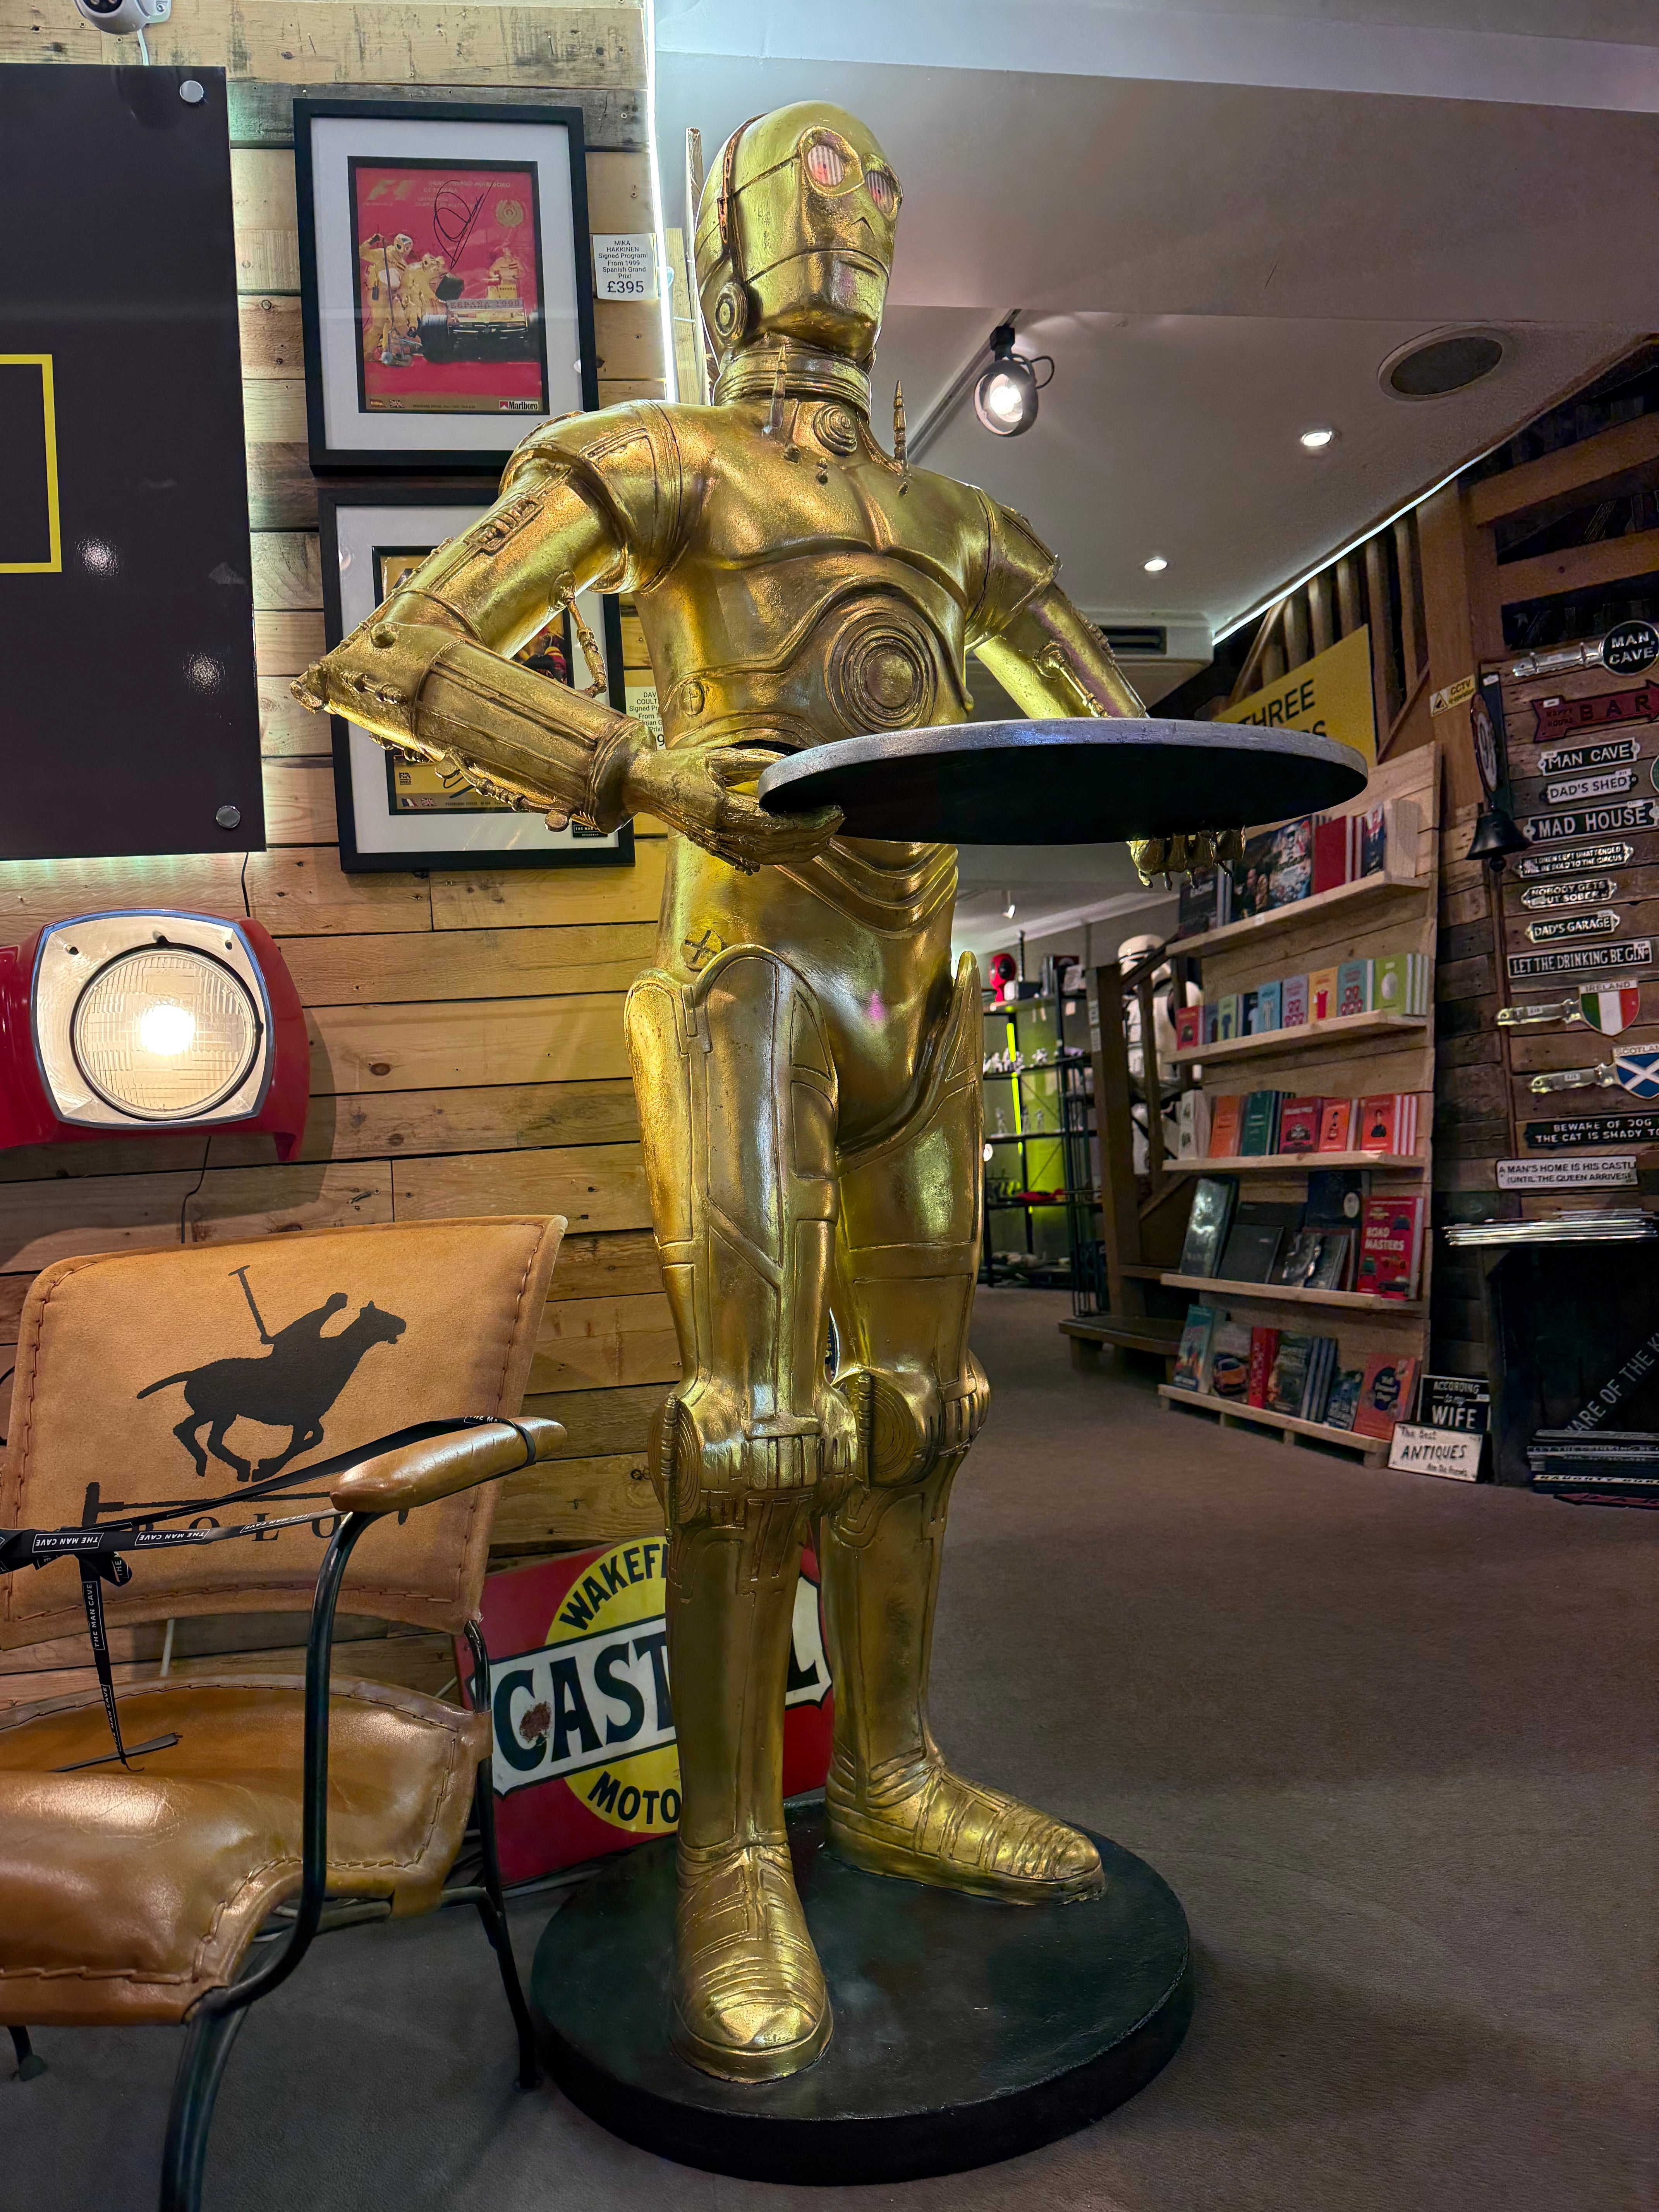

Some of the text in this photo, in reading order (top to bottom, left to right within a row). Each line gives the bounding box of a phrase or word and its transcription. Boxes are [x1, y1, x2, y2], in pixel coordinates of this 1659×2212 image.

[607, 280, 644, 293] £395
[450, 300, 491, 309] ESPAÑA
[508, 401, 538, 410] Marlboro
[1611, 631, 1650, 648] MAN
[1609, 646, 1654, 665] CAVE
[1450, 679, 1471, 694] CCTV
[1580, 695, 1652, 722] BAR
[1548, 743, 1630, 769] MAN CAVE
[1550, 776, 1627, 798] DAD'S SHED
[1539, 806, 1647, 838] MAD HOUSE
[1596, 854, 1623, 864] CIRCUS
[1531, 881, 1606, 896] NOBODY GETS
[1547, 891, 1600, 904] UT SOBER
[1534, 917, 1611, 937] DAD'S GARAGE
[1513, 958, 1532, 974] LET
[1534, 955, 1556, 972] THE
[1556, 949, 1609, 969] DRINKING
[1585, 981, 1631, 993] IRELAND
[1616, 1044, 1659, 1055] SCOTLA
[1553, 1121, 1601, 1132] BEWARE
[1606, 1120, 1621, 1129] OF
[1535, 1134, 1559, 1143] THE
[1561, 1132, 1582, 1142] CAT
[1587, 1131, 1599, 1140] IS
[1602, 1128, 1642, 1140] SHADY
[1507, 1164, 1539, 1173] MAN'S
[1539, 1163, 1568, 1172] HOME
[1571, 1163, 1581, 1171] IS
[1582, 1162, 1599, 1170] HIS
[1538, 1175, 1554, 1183] THE
[1556, 1173, 1587, 1182] QUEEN
[1366, 1227, 1390, 1238] ROAD
[1365, 1238, 1405, 1251] MASTERS
[1599, 1379, 1622, 1404] OF
[1618, 1350, 1656, 1382] THE
[1433, 1381, 1480, 1395] ACCORDING
[1432, 1405, 1477, 1430] WIFE
[1401, 1444, 1468, 1461] ANTIQUES
[244, 1521, 268, 1530] CAVE
[559, 1542, 667, 1631] WAKEFI
[103, 1687, 111, 1709] CAVE
[494, 1630, 820, 1772] CASTL
[587, 1770, 682, 1825] MOTO
